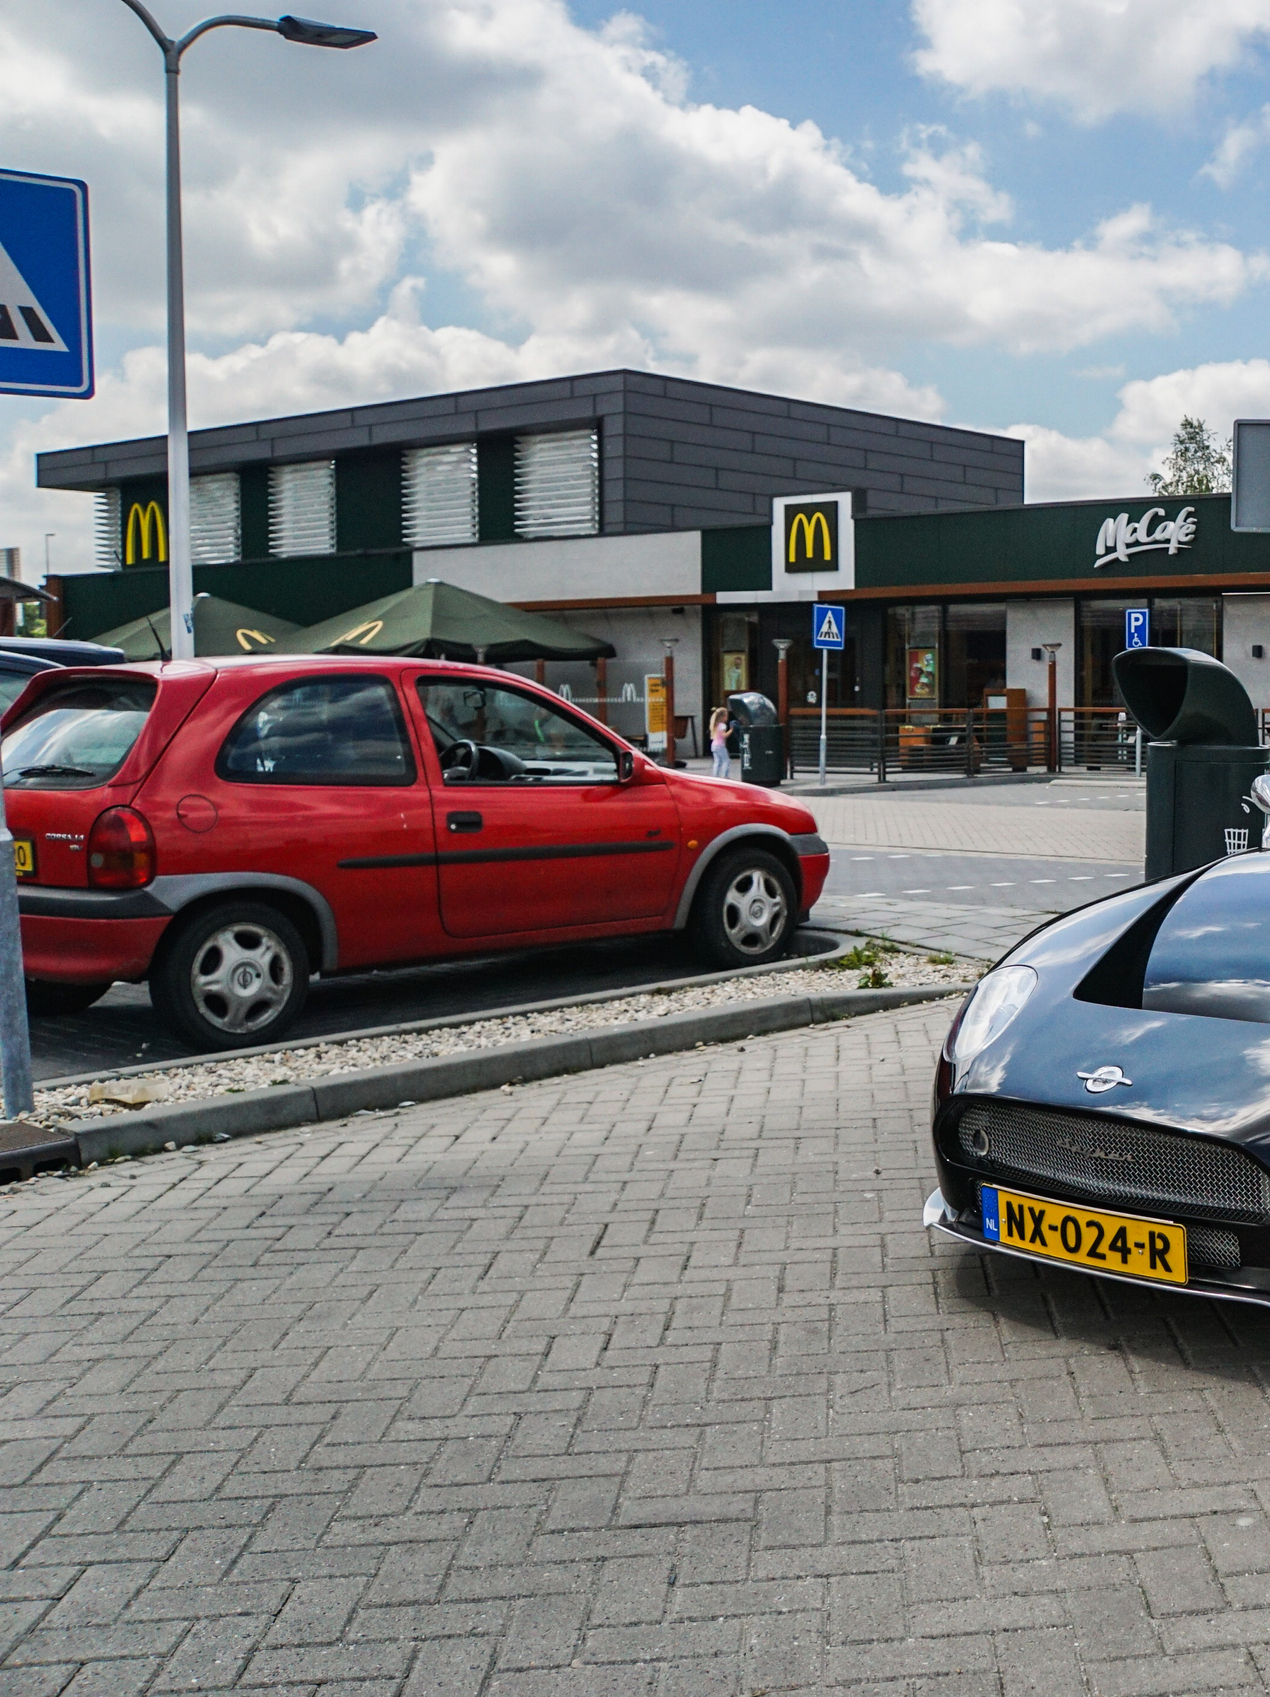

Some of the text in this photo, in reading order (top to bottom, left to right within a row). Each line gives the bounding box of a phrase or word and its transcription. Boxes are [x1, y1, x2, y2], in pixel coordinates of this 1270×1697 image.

[1094, 506, 1198, 568] McCafé
[1130, 613, 1143, 632] P
[985, 1218, 998, 1231] NL
[1006, 1200, 1173, 1273] NX-024-R
